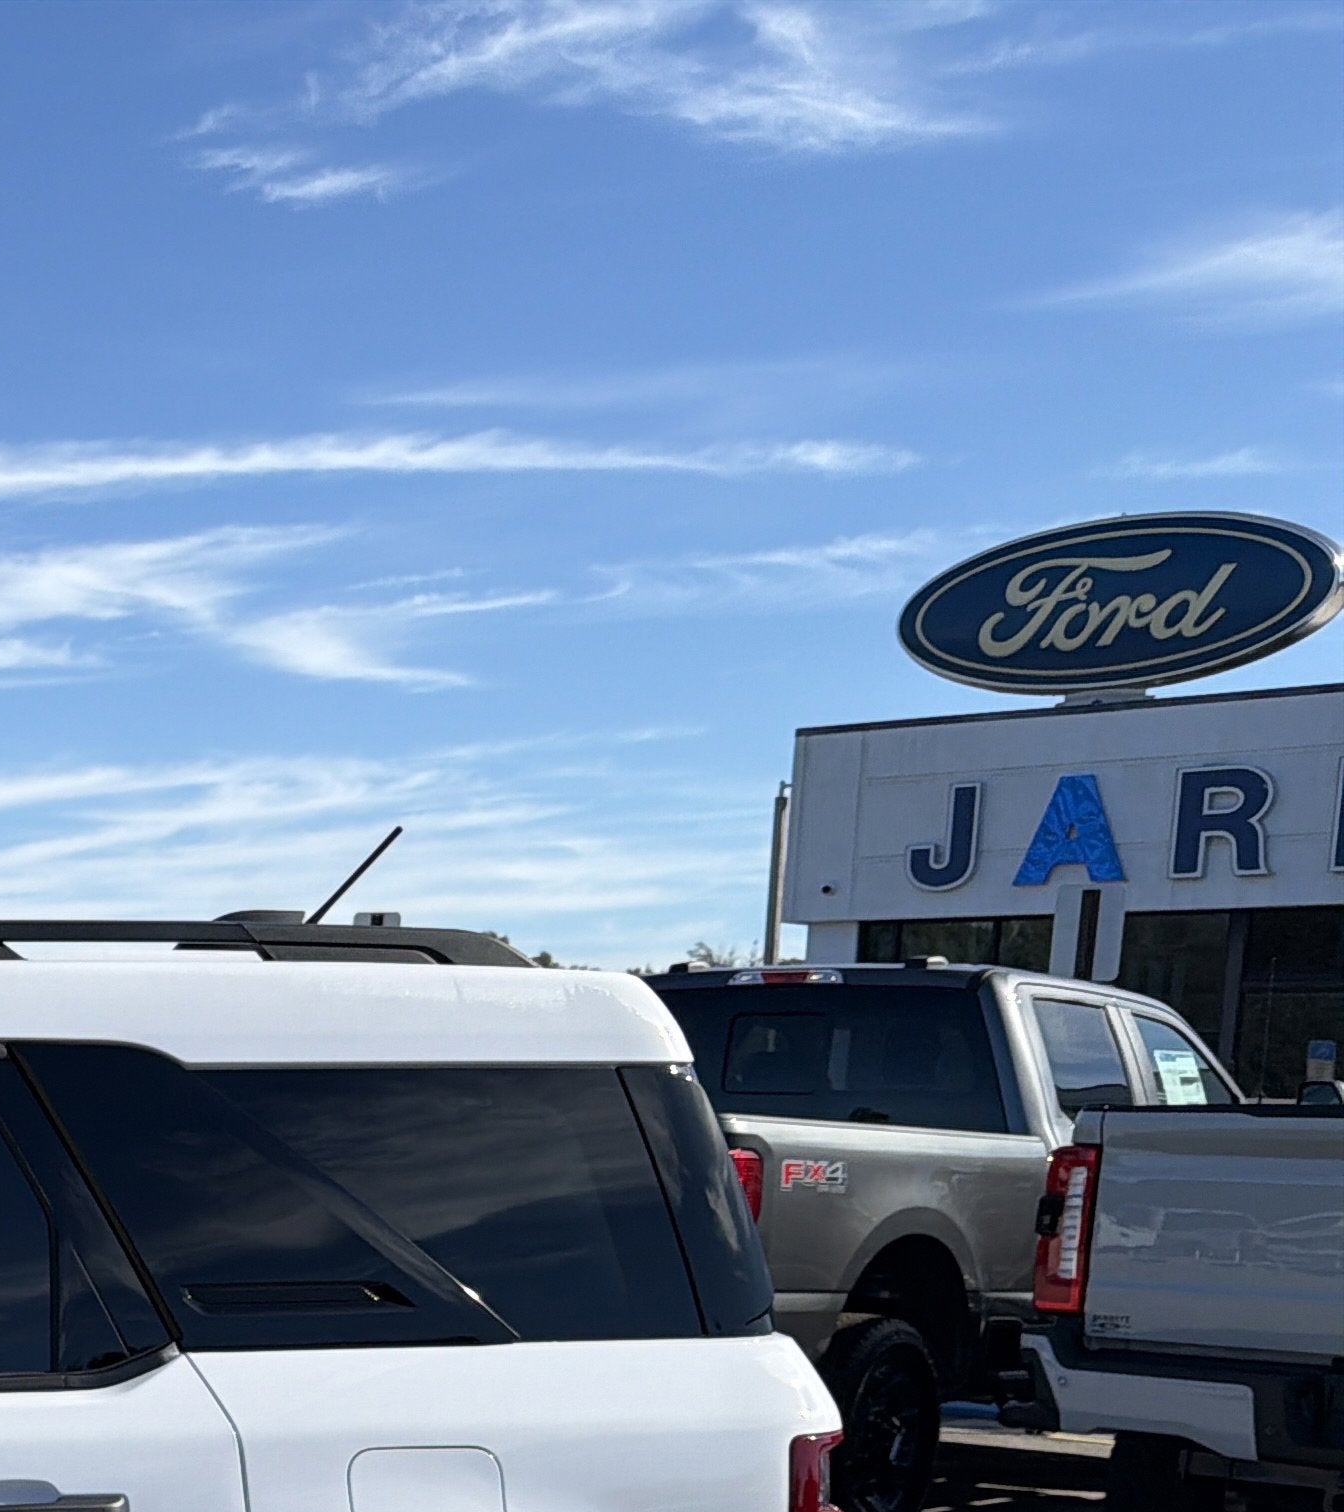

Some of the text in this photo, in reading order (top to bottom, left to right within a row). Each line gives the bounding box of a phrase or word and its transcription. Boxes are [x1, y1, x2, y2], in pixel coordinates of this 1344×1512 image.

[978, 549, 1238, 658] Ford
[905, 757, 1344, 892] JAR
[780, 1159, 848, 1191] FX4
